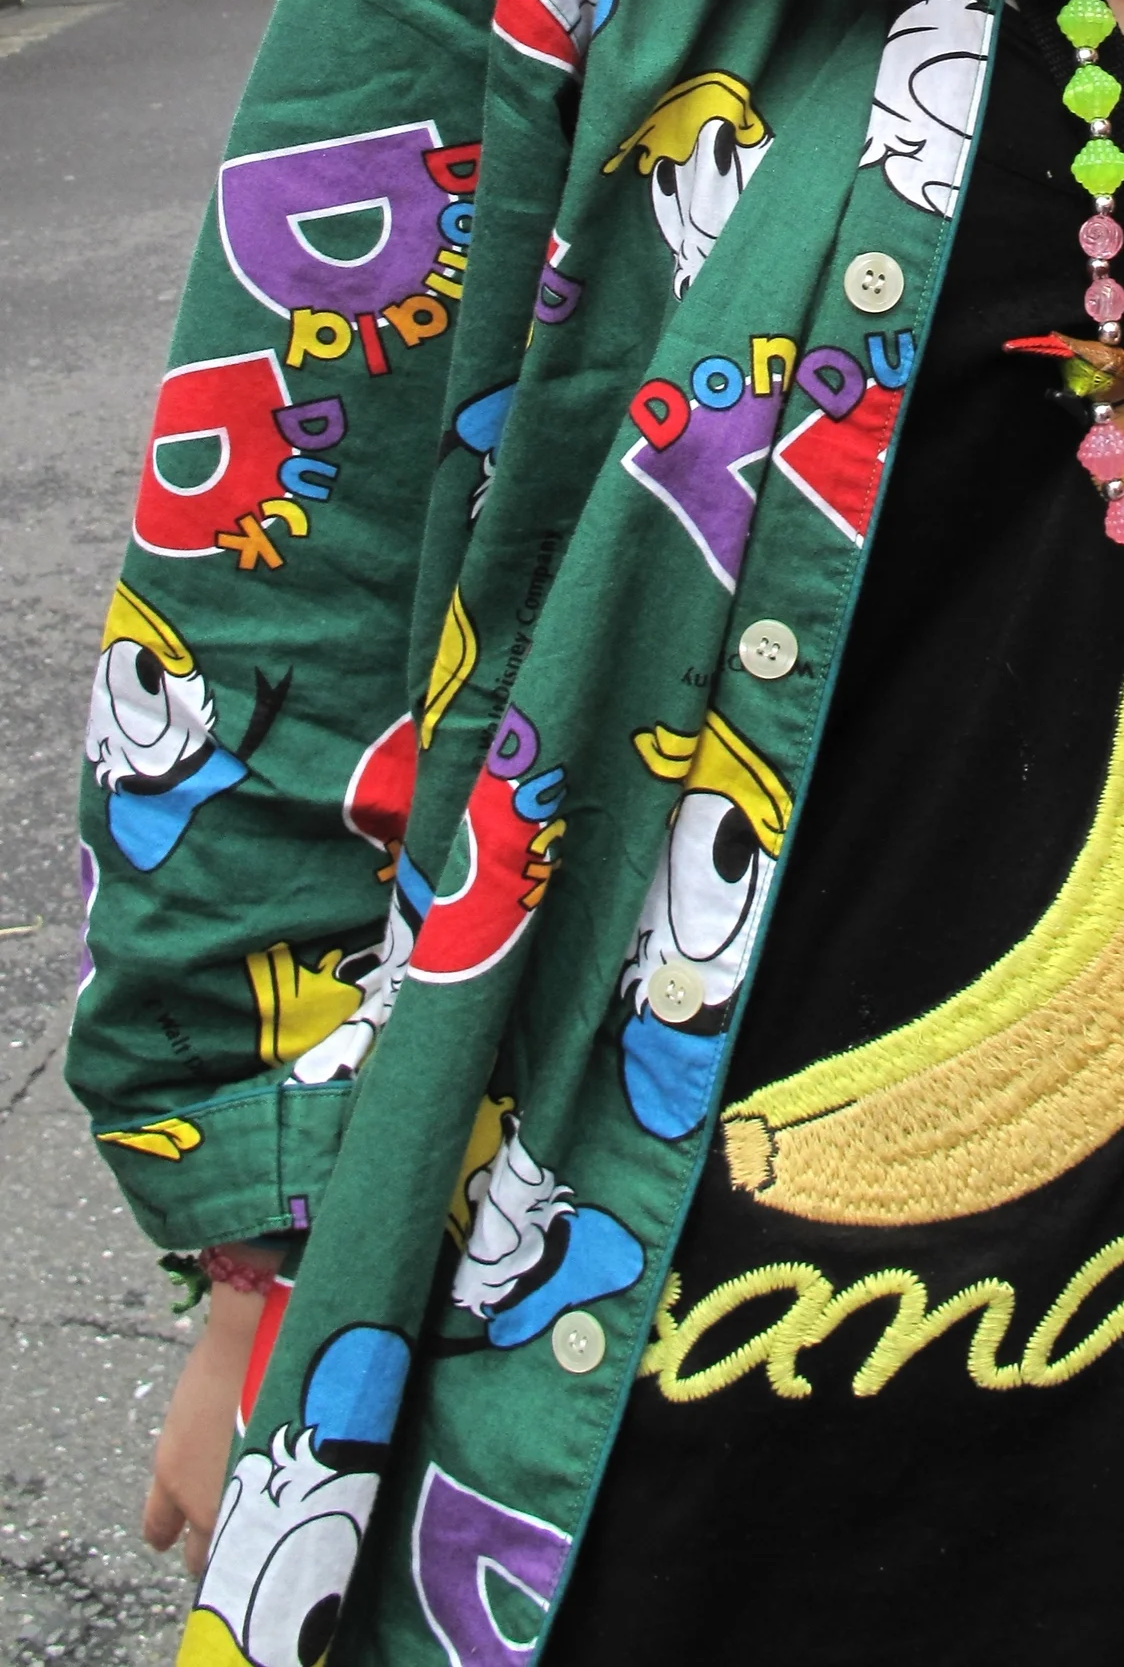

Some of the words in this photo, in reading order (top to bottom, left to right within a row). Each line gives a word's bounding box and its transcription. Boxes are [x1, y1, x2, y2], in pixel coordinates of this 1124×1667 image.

[793, 329, 918, 424] Du
[214, 395, 349, 572] Duck
[515, 529, 565, 626] Company
